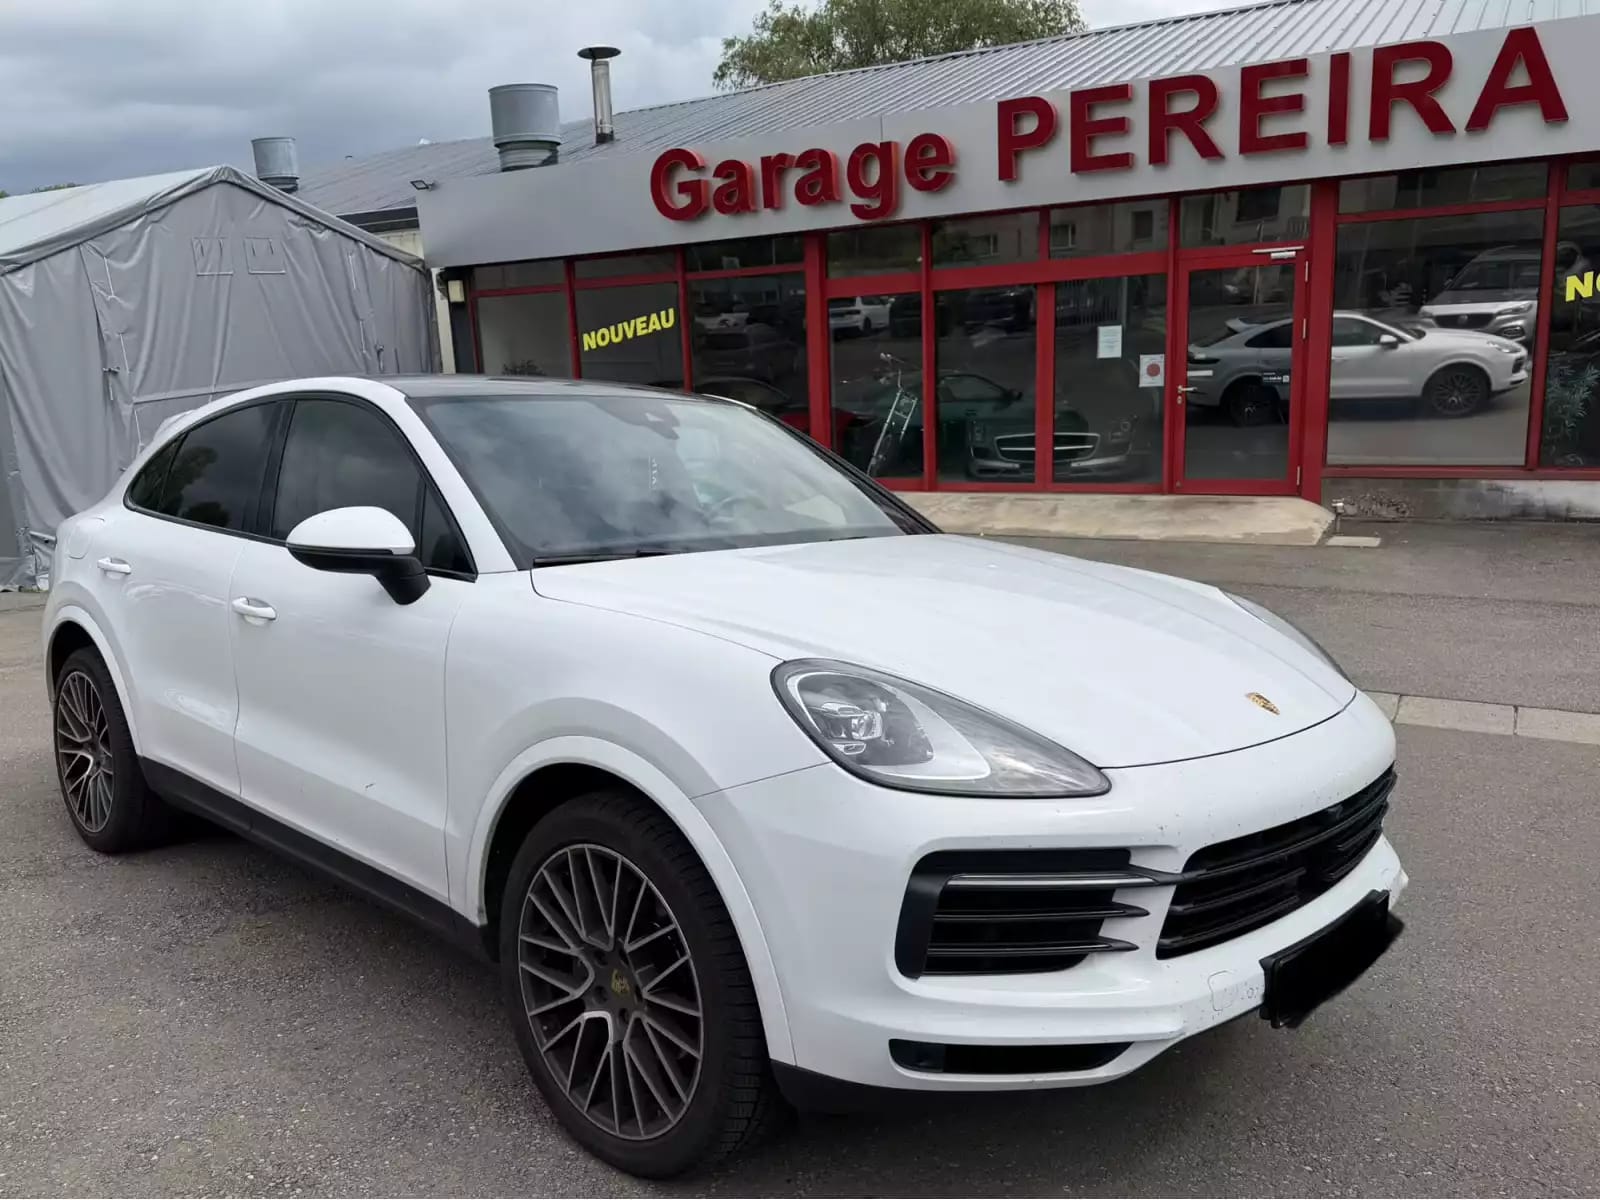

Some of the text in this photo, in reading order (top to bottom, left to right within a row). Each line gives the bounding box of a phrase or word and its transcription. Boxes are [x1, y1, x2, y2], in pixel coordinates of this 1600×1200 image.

[650, 26, 1569, 221] Garage PEREIRA
[582, 308, 675, 352] NOUVEAU
